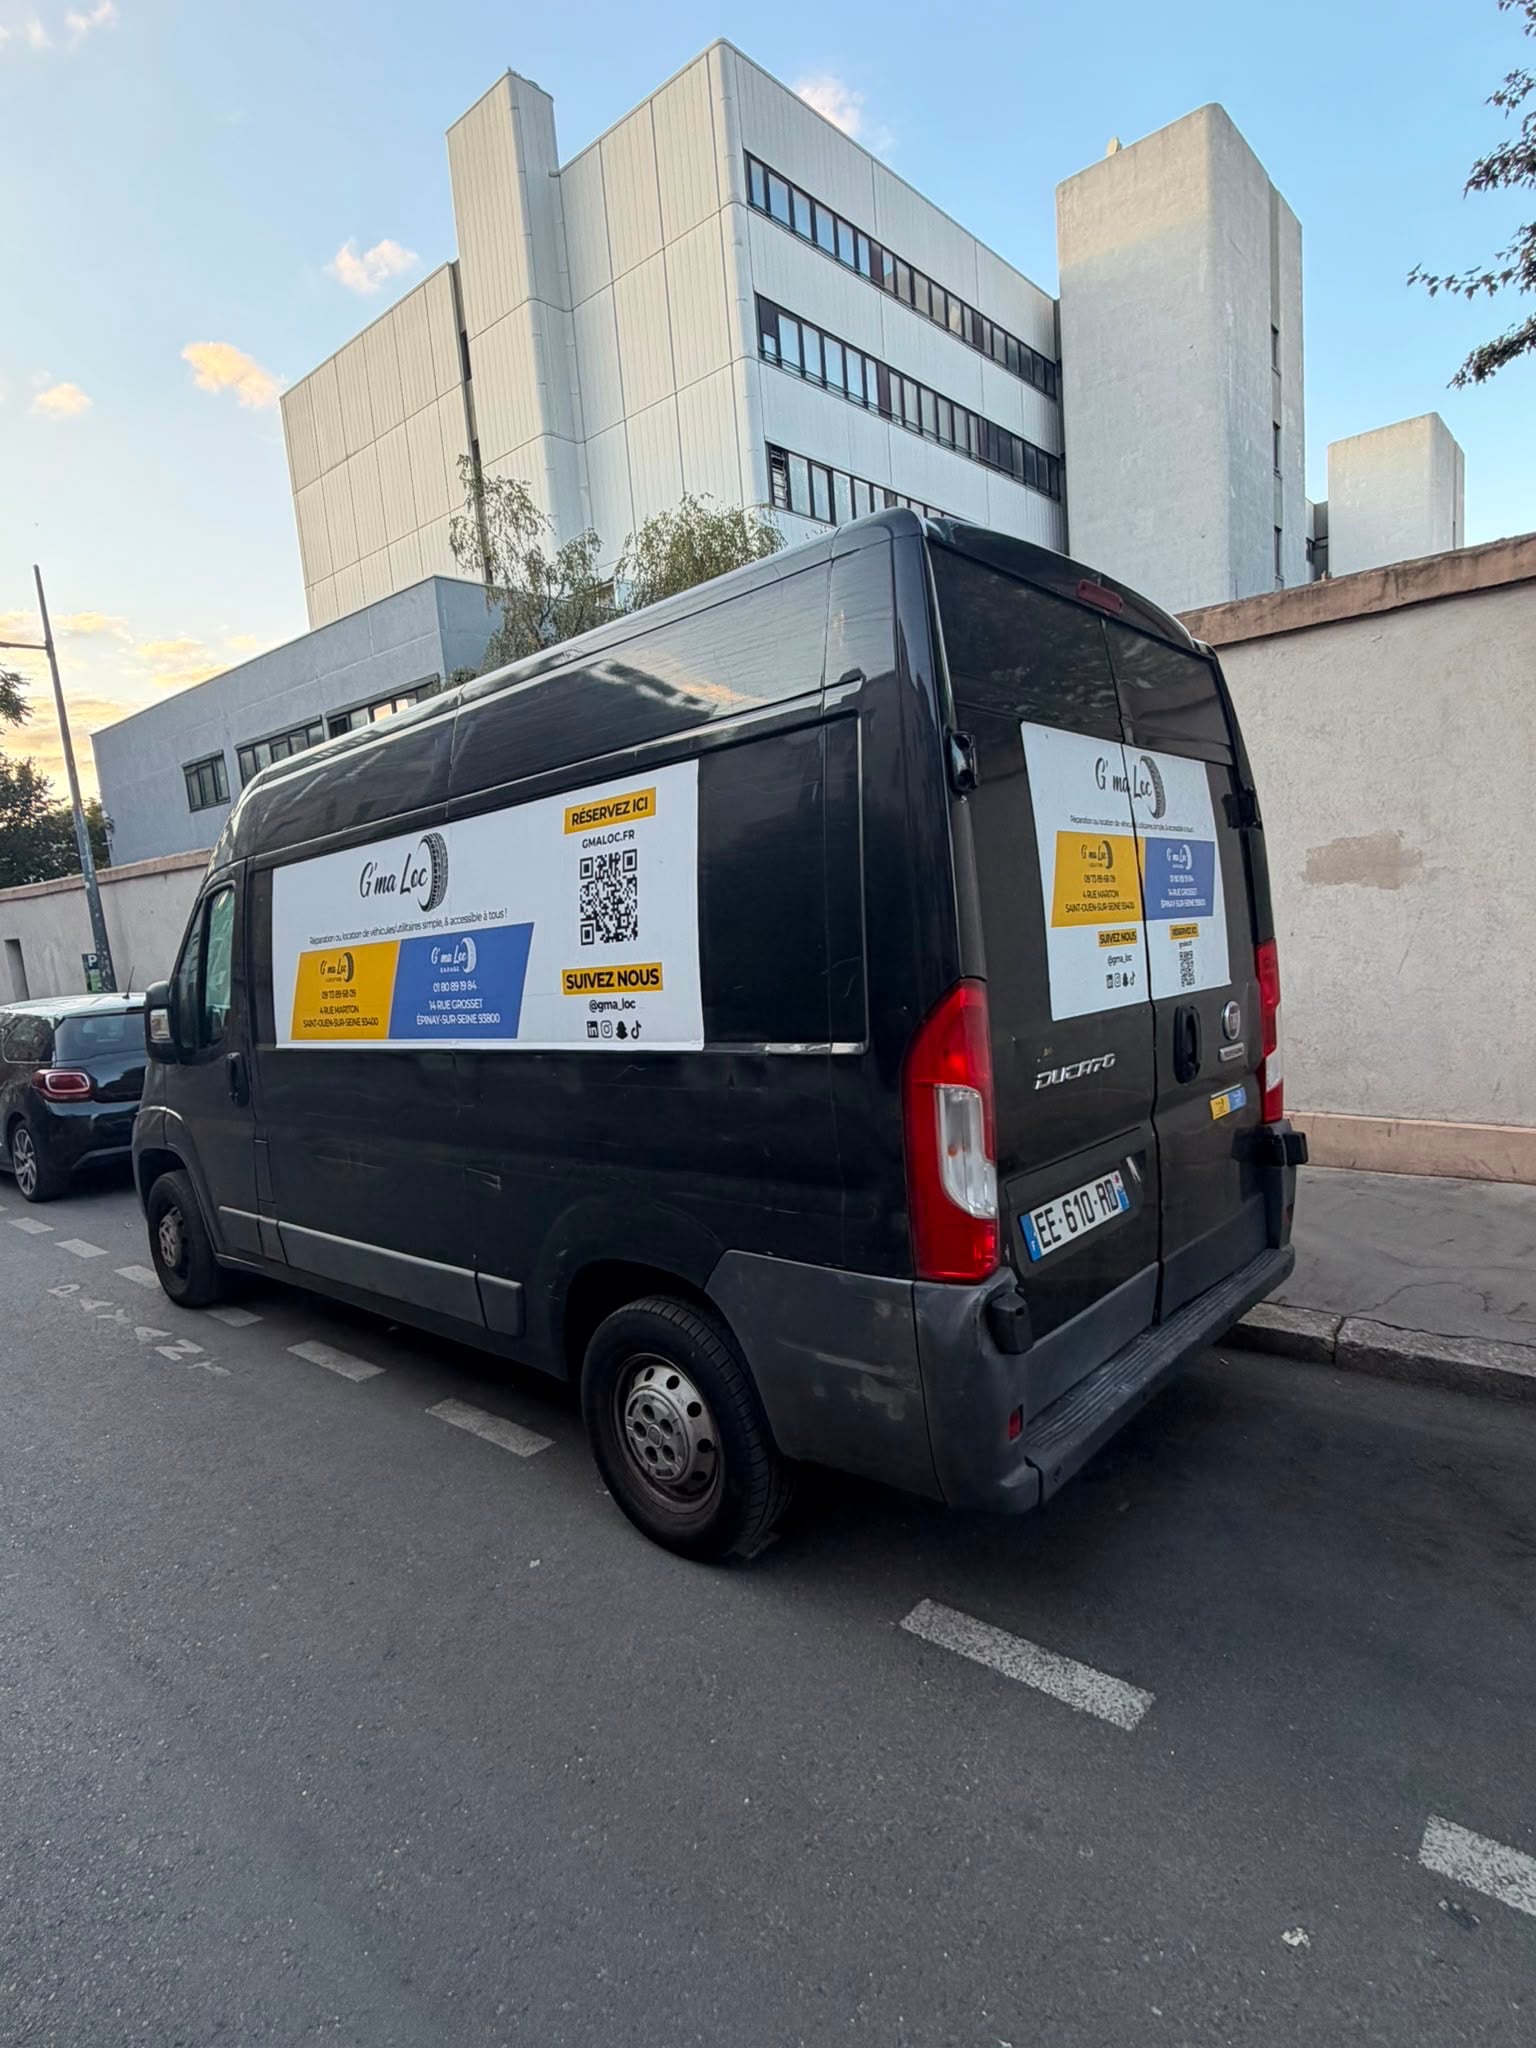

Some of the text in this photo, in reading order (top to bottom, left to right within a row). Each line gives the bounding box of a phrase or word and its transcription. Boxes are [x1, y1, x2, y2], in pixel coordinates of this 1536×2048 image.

[571, 796, 648, 826] RÉSERVEZ ICI
[582, 829, 635, 848] GMALOC.FR
[450, 911, 482, 925] accessible
[1099, 932, 1120, 944] SUIVEZ
[88, 955, 97, 967] P
[566, 968, 659, 990] SUIVEZ NOUS
[429, 998, 483, 1010] 14 RUE GROSSET
[589, 998, 636, 1013] @gma_loc
[1034, 1053, 1115, 1090] DUCATO
